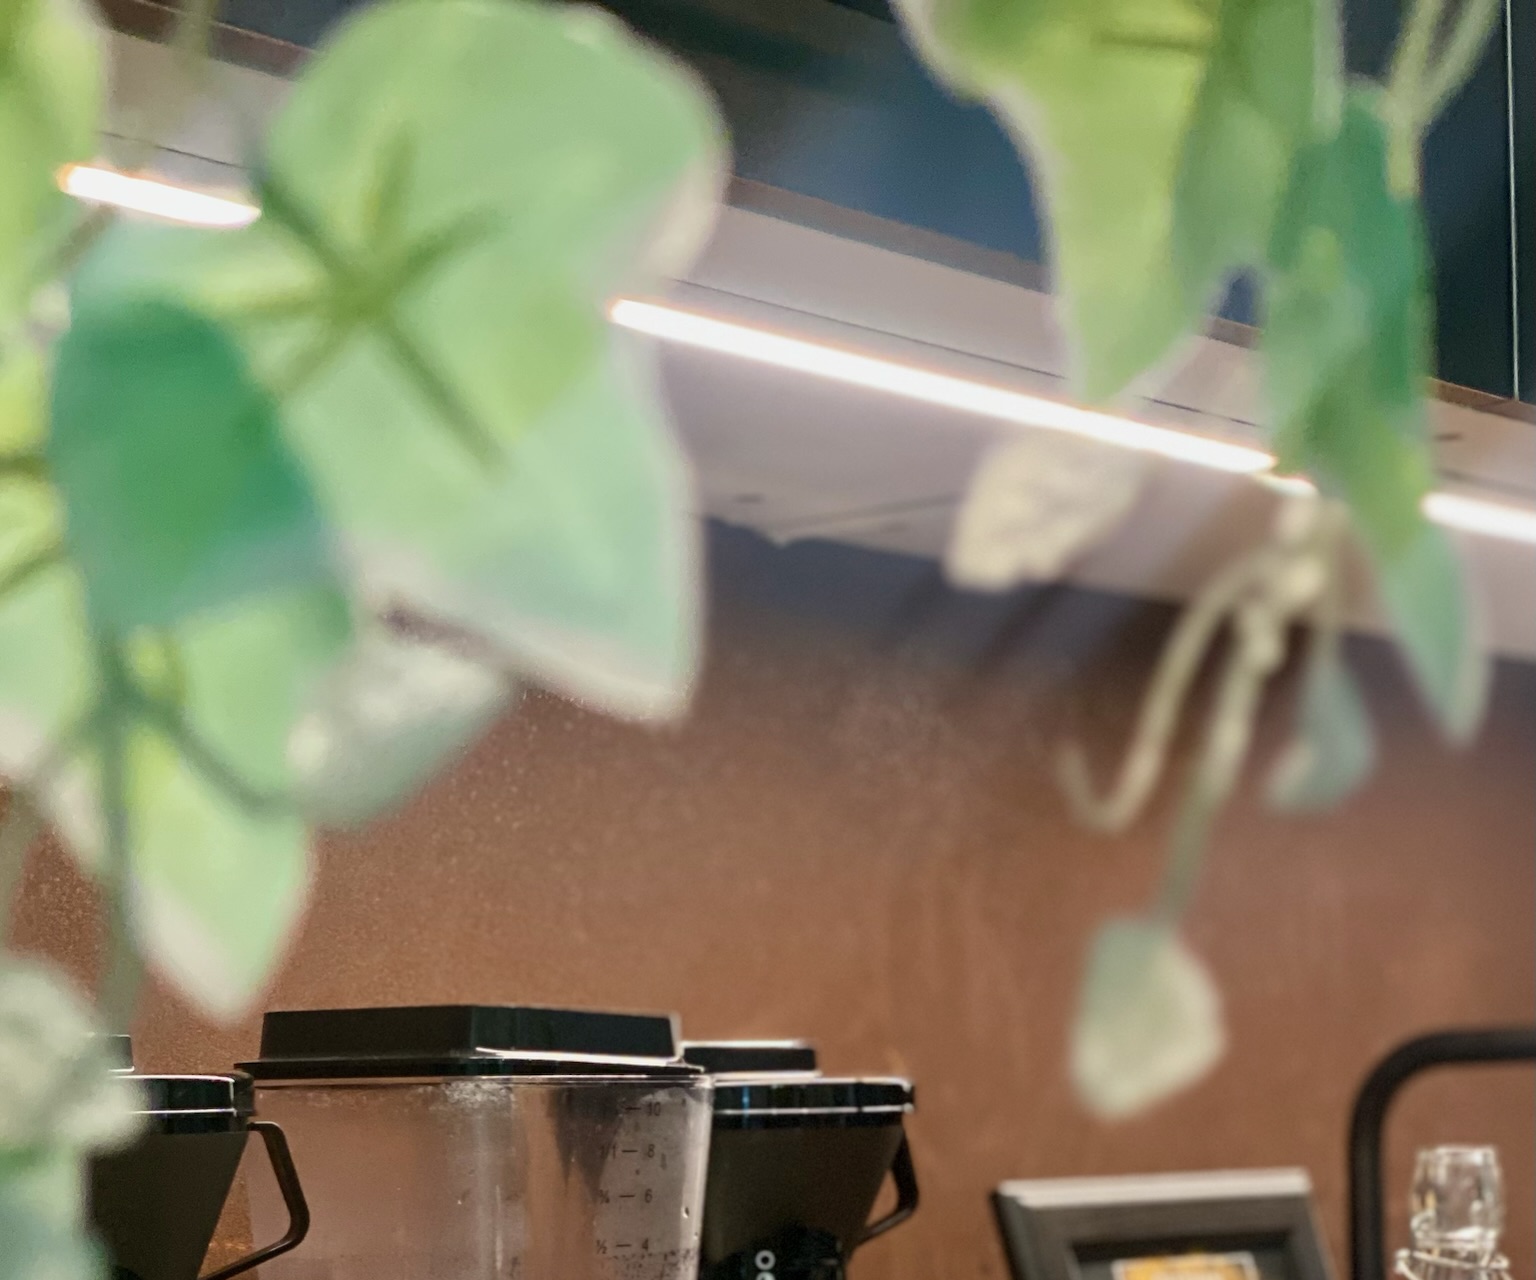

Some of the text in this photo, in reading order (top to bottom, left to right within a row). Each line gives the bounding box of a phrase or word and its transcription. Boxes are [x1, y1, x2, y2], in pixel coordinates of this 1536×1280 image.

[646, 1101, 662, 1117] 10
[647, 1144, 655, 1158] 8
[645, 1188, 653, 1203] 6
[642, 1238, 649, 1251] 4
